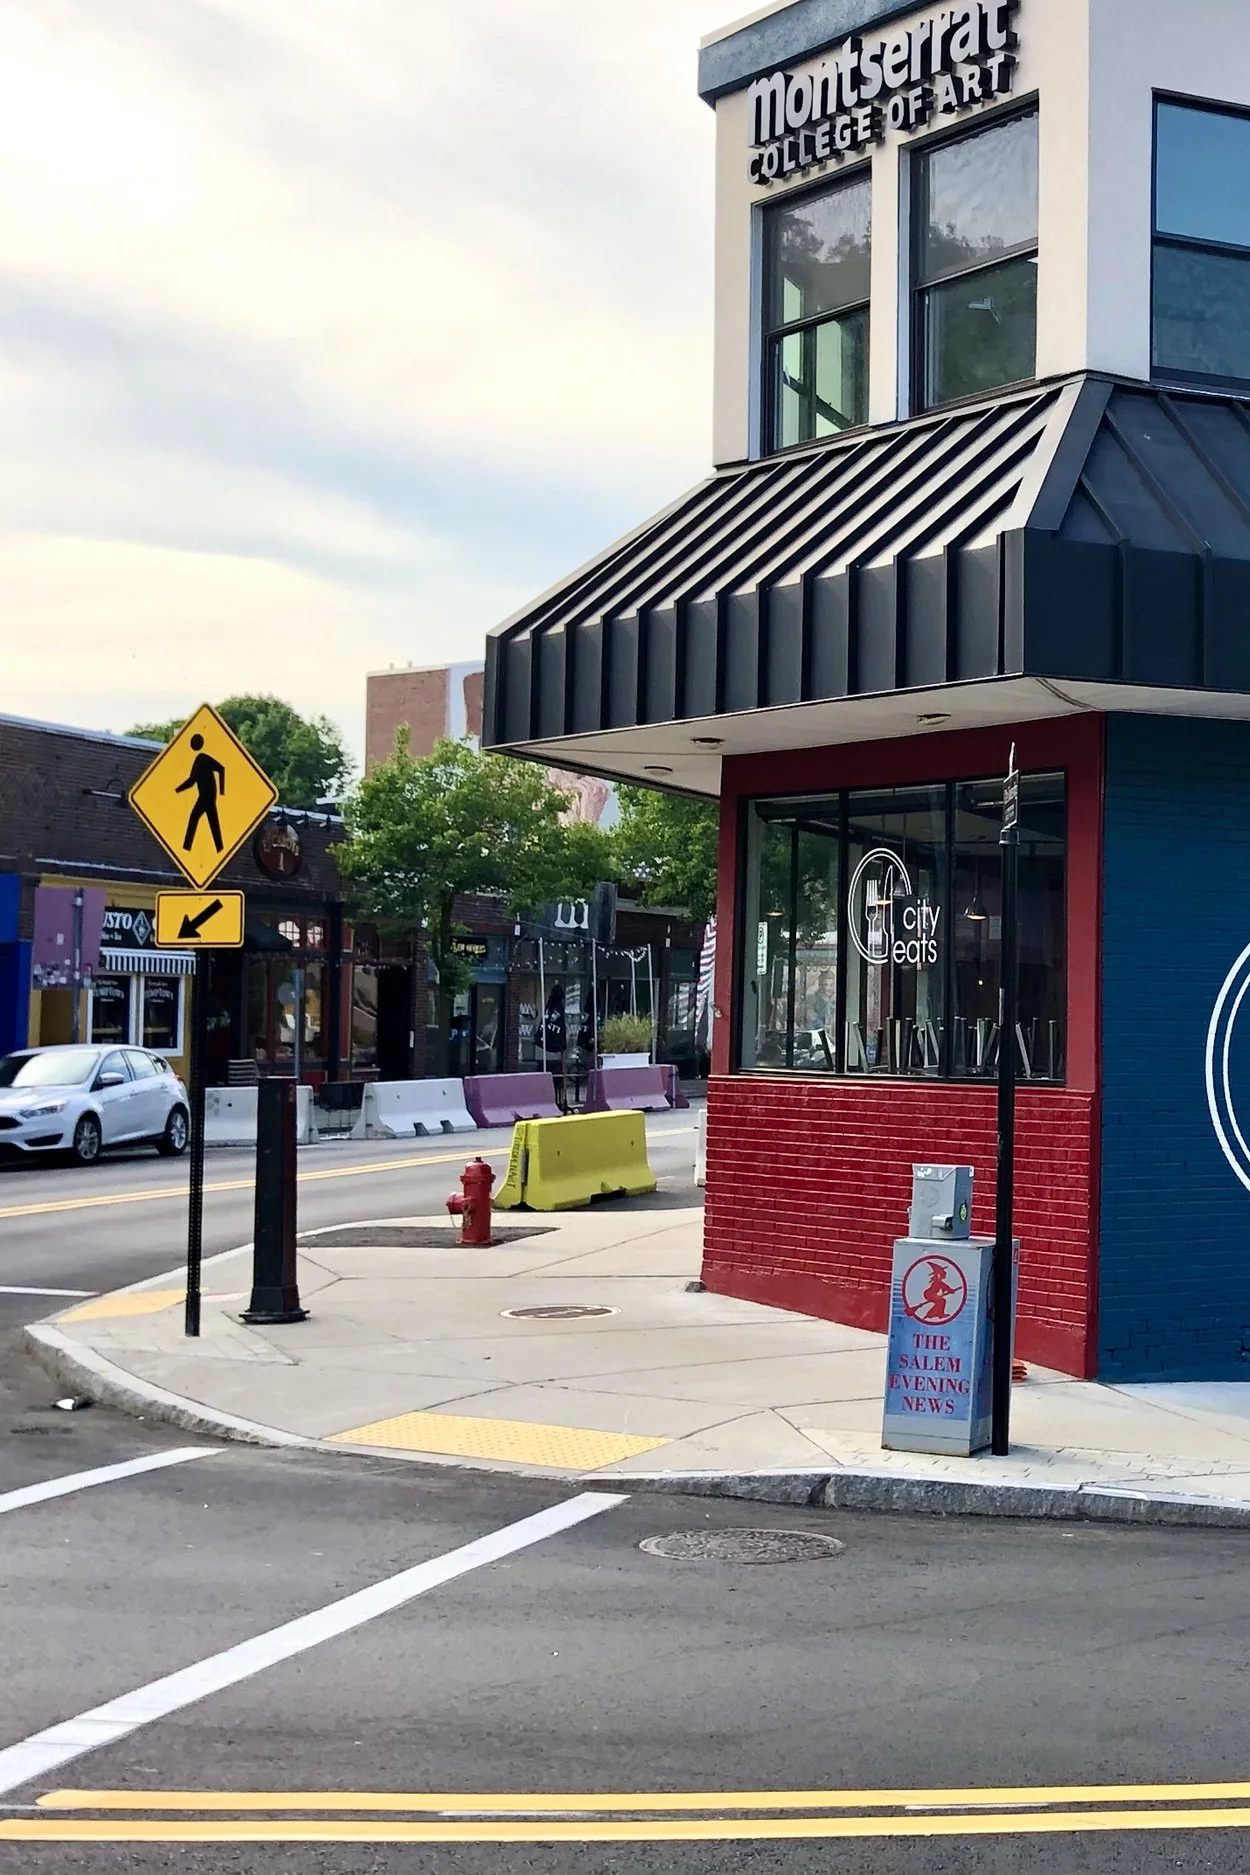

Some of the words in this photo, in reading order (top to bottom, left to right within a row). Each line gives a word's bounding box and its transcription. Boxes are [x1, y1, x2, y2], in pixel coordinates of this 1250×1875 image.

[746, 102, 873, 184] COLLEGE
[886, 89, 926, 131] OF
[937, 53, 1006, 116] ART
[903, 898, 941, 937] city
[893, 933, 938, 964] eats
[912, 1333, 951, 1351] THE
[899, 1353, 961, 1373] SALEM
[888, 1373, 970, 1395] EVENING
[902, 1395, 955, 1415] NEWS
